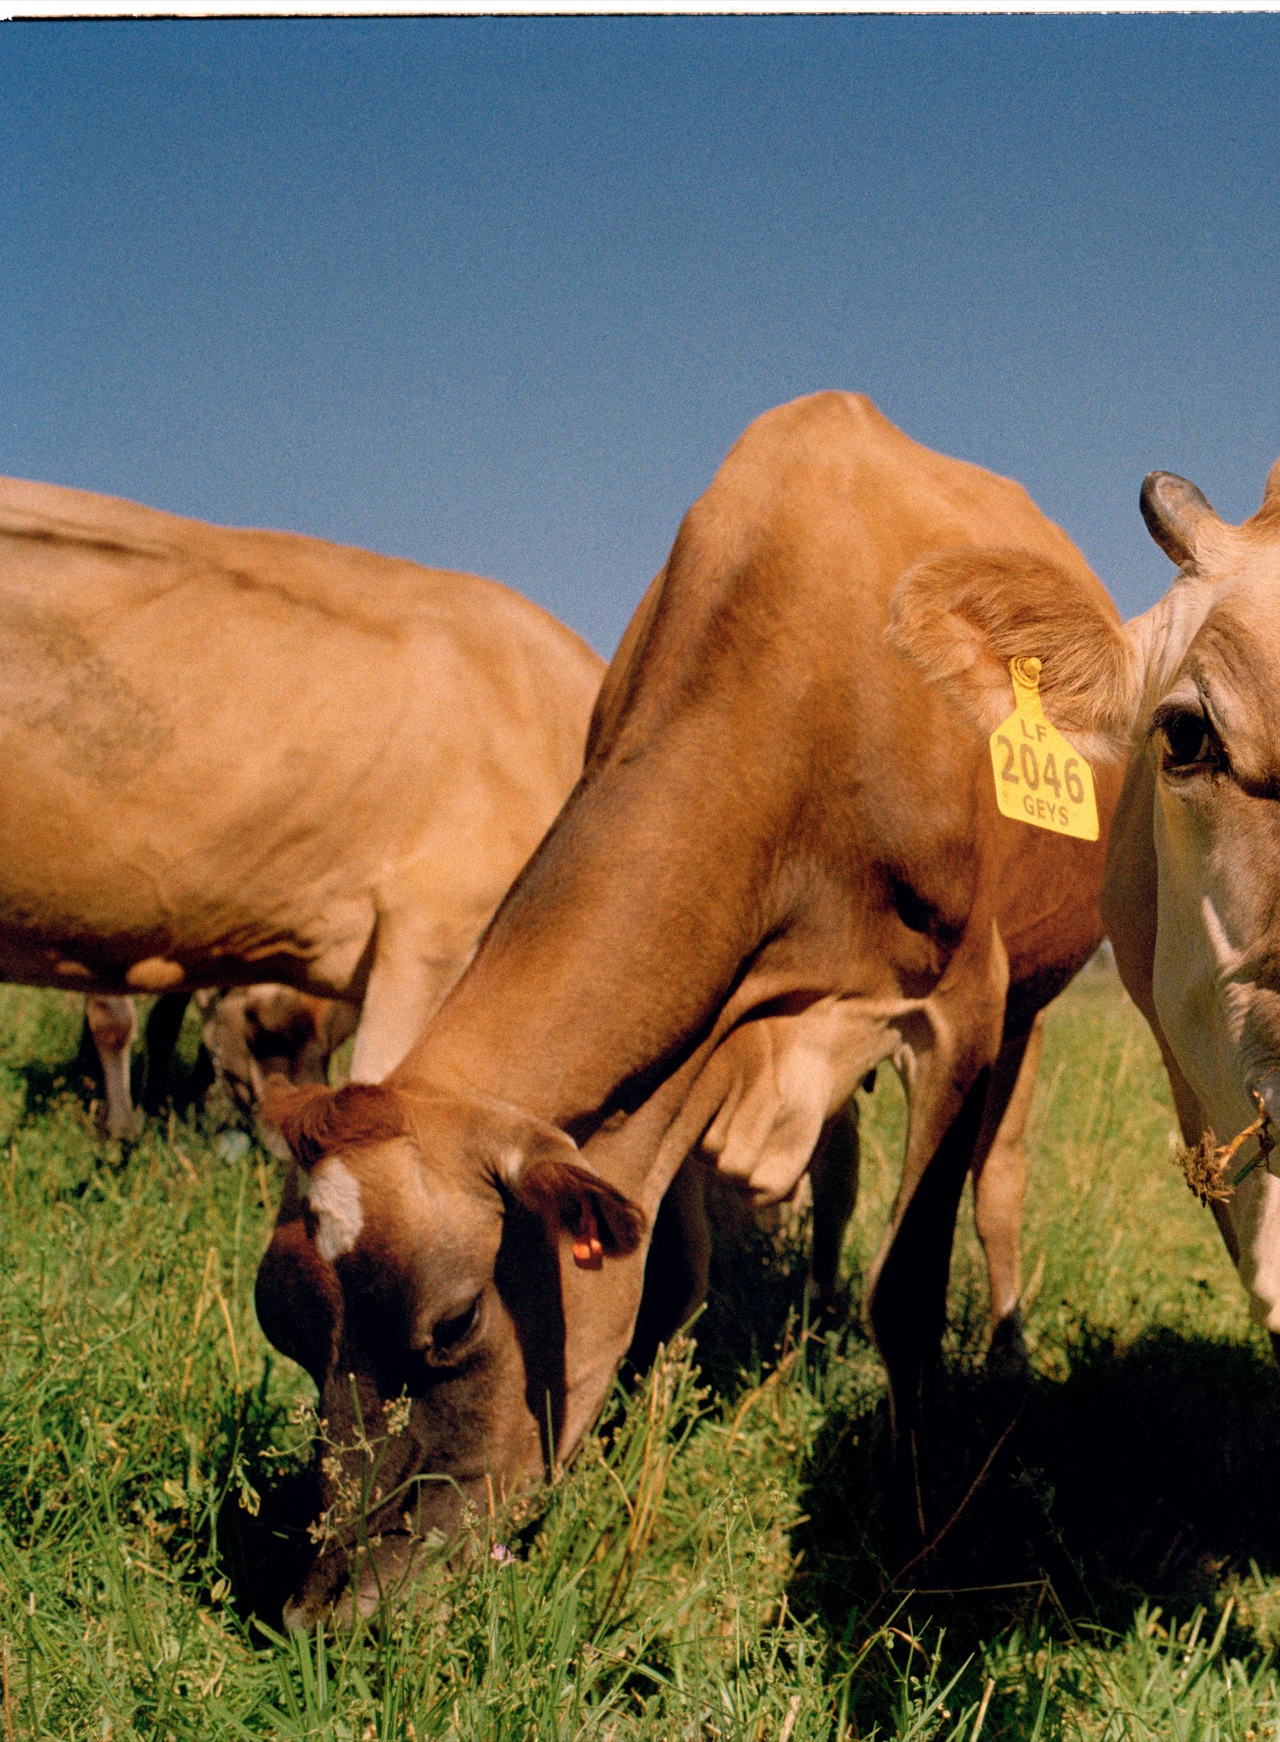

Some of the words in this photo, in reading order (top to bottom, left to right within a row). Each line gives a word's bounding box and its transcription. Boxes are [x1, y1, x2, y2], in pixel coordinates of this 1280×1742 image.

[1020, 718, 1047, 742] LF
[997, 735, 1084, 805] 2046
[1023, 794, 1069, 826] GEYS
